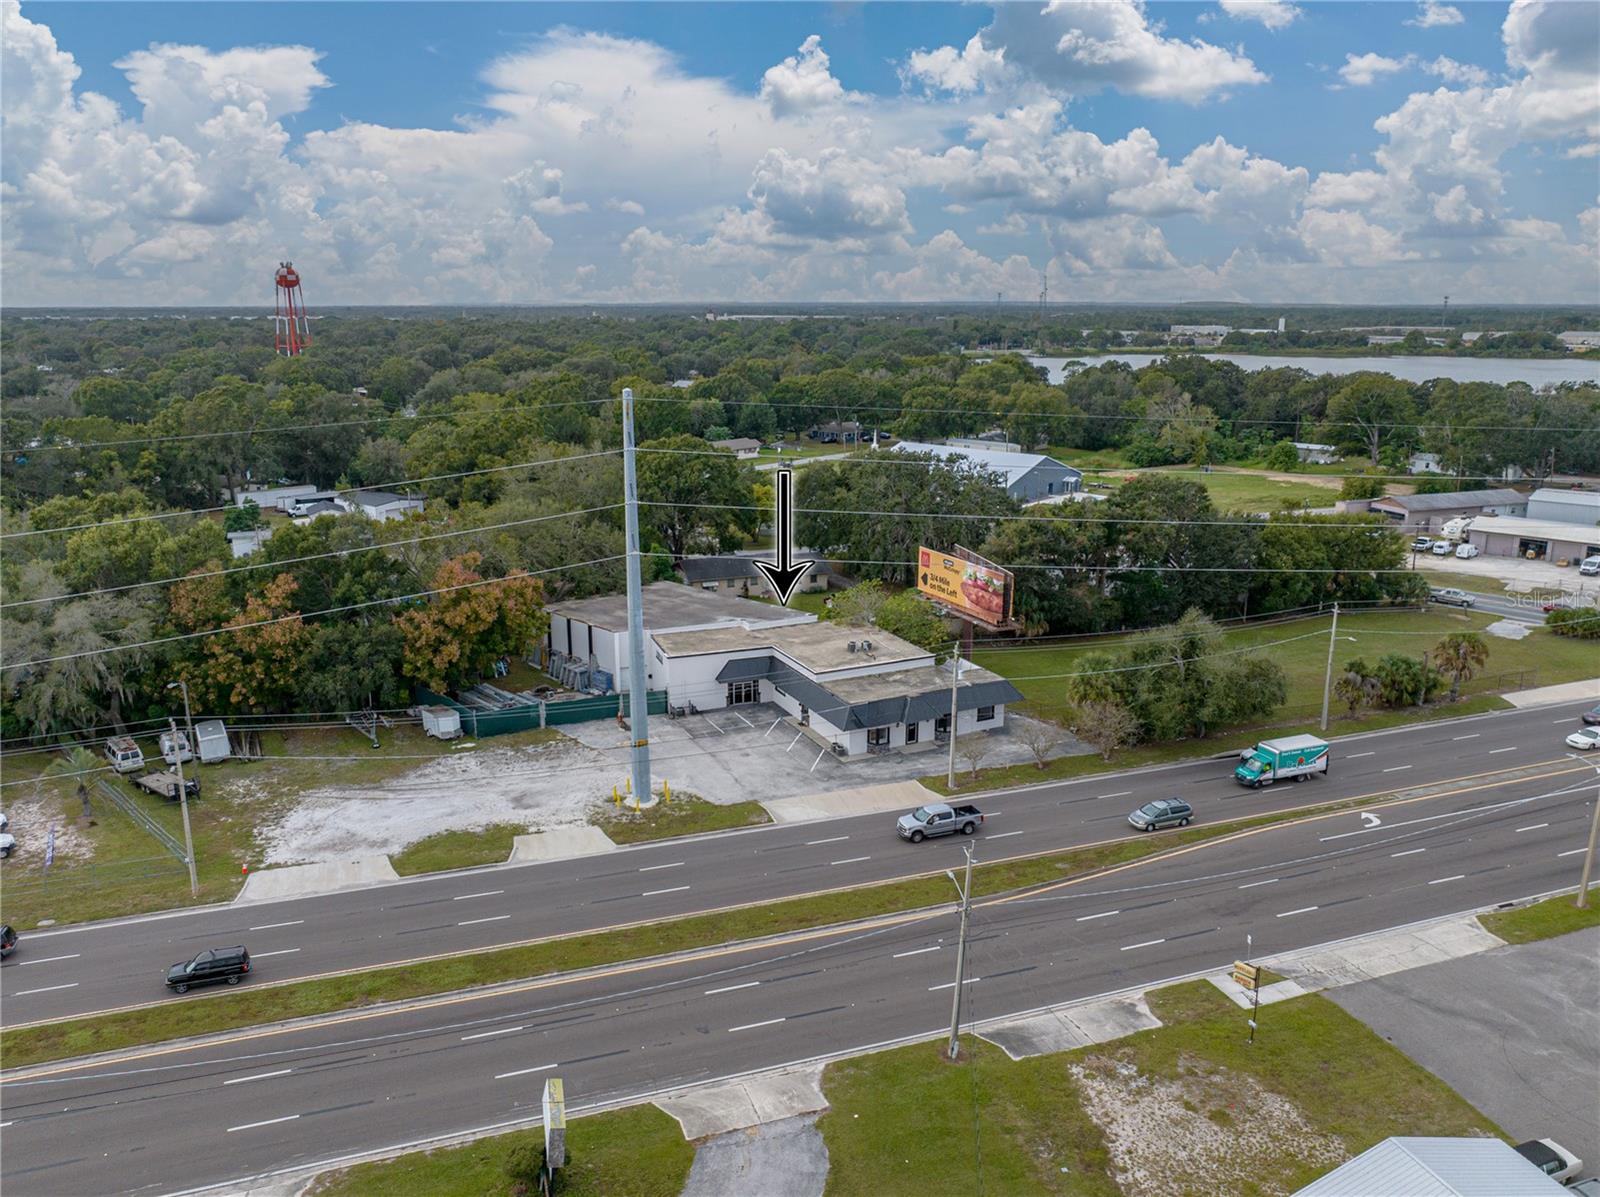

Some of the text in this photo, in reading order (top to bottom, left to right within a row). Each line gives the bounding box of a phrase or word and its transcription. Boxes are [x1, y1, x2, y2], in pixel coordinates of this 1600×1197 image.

[930, 573, 950, 587] 3/4 Mile
[929, 583, 958, 599] on the Left
